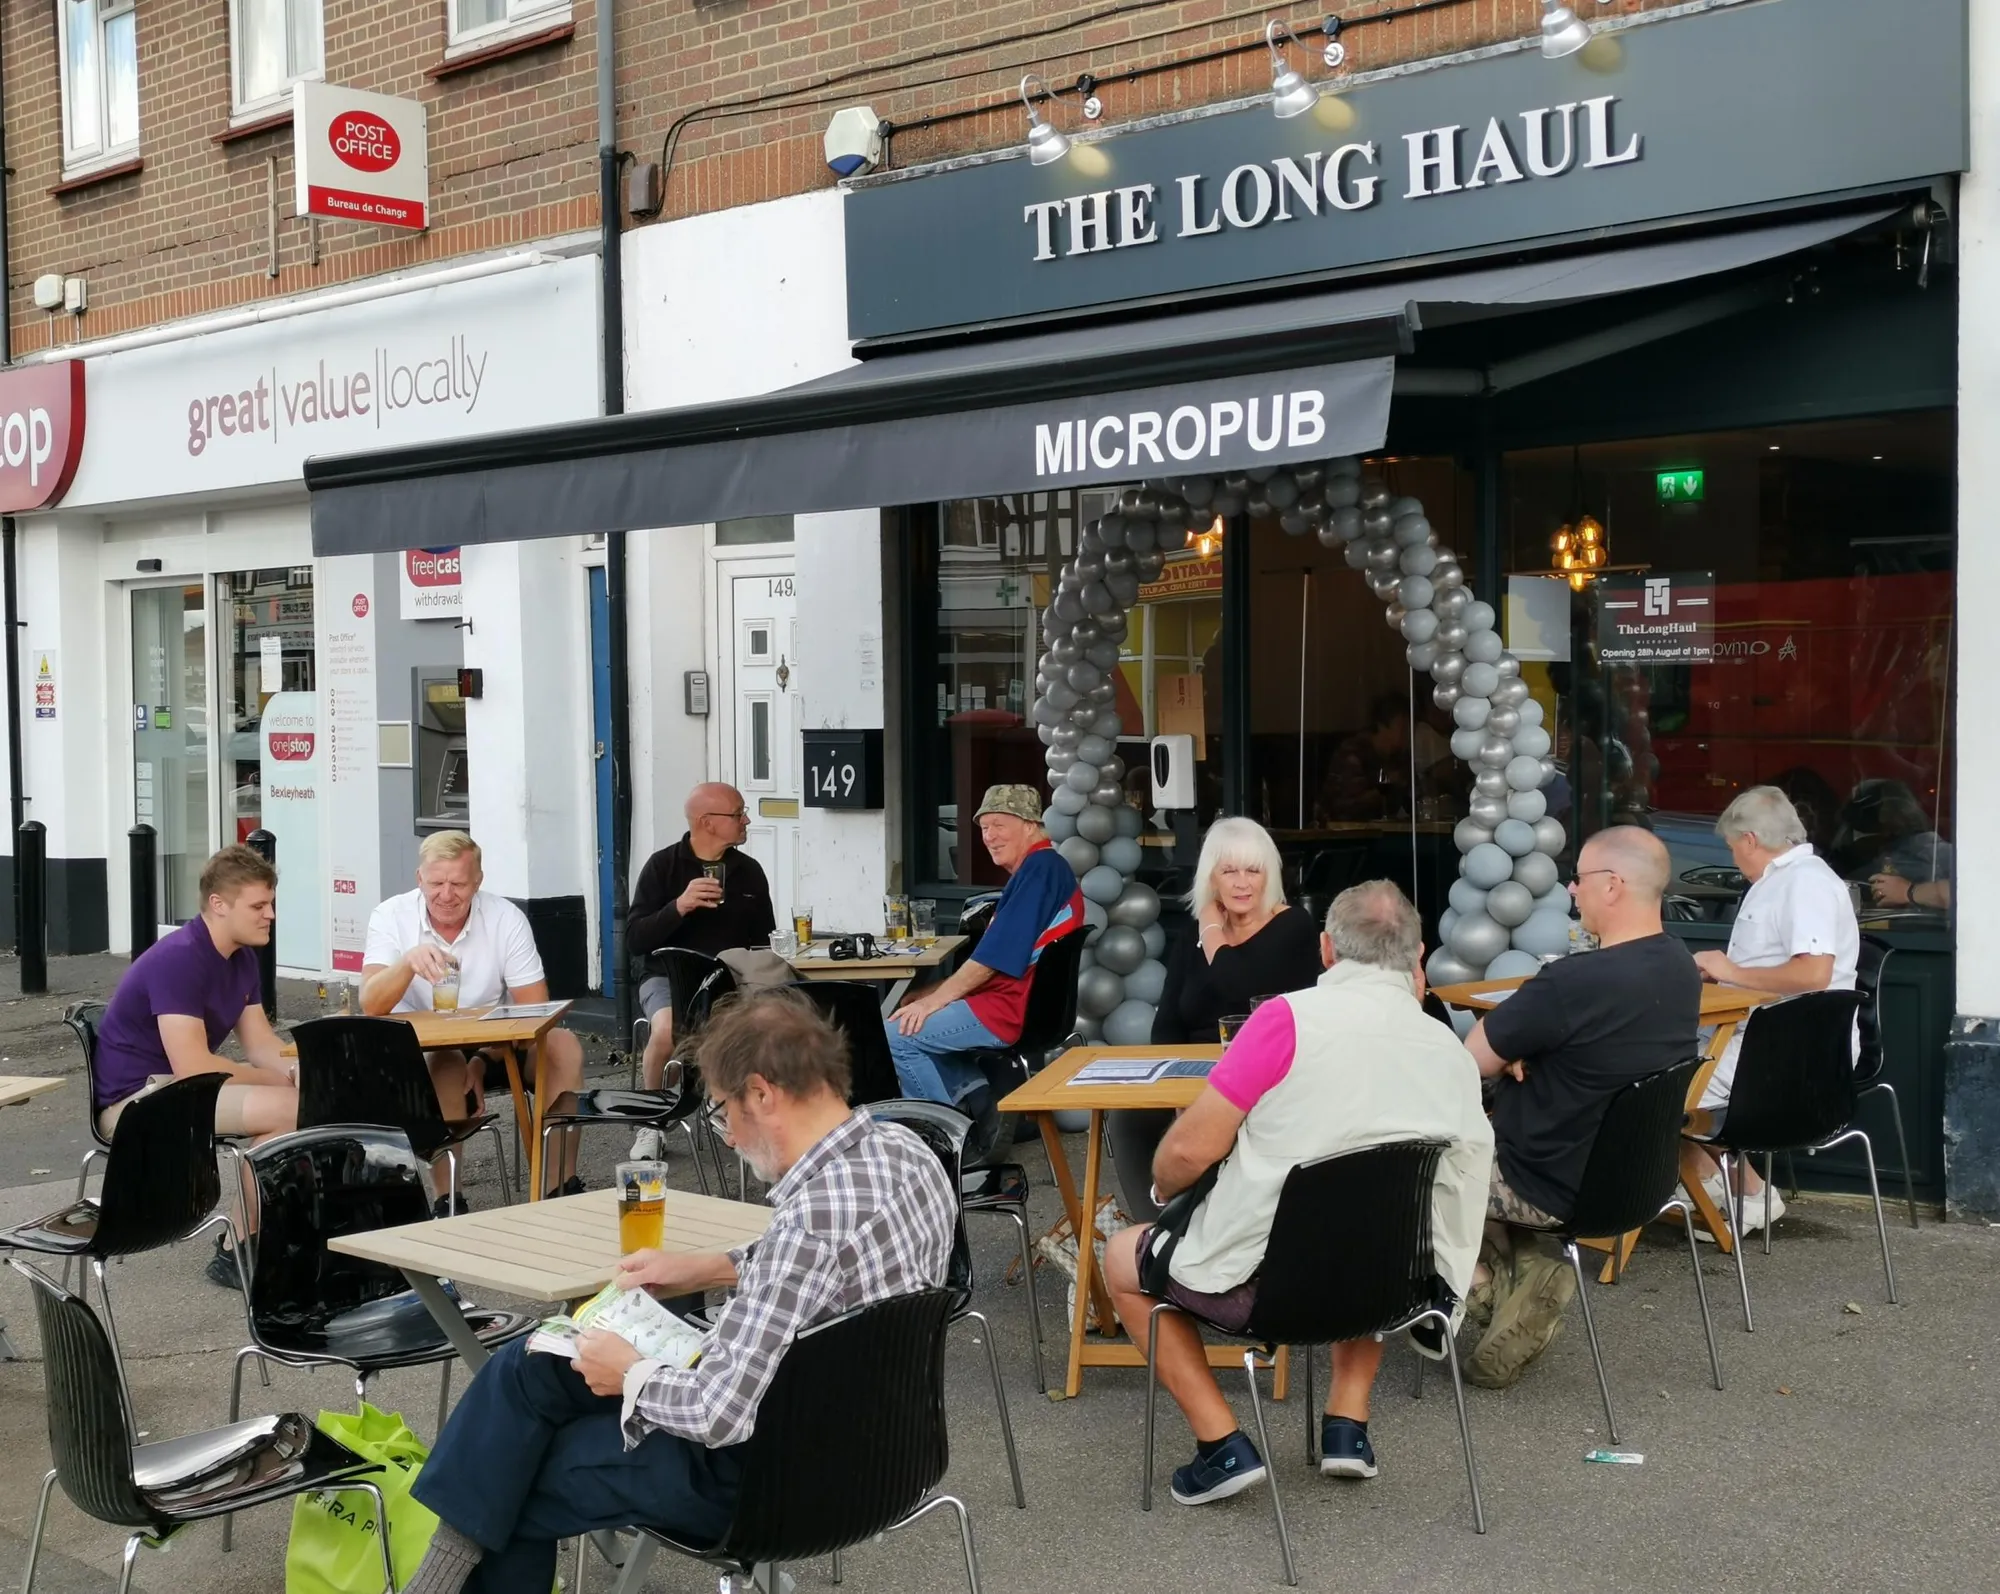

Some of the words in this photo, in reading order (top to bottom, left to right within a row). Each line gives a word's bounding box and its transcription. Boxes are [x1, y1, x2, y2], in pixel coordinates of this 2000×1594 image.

[345, 121, 387, 142] POST
[335, 137, 393, 160] OFFICE
[1024, 182, 1158, 261] THE
[1175, 141, 1378, 238] LONG
[1401, 95, 1639, 199] HAUL
[327, 196, 360, 211] Bureau
[362, 202, 373, 212] de
[375, 204, 407, 218] Change
[188, 375, 270, 456] great
[281, 358, 371, 423] value
[384, 334, 488, 414] locally
[1035, 389, 1326, 476] MICROPUB
[412, 555, 434, 576] free
[437, 557, 461, 574] cas
[1617, 622, 1697, 636] TheLongHaul
[1601, 649, 1635, 658] Opening
[1637, 648, 1654, 656] 28th
[1655, 648, 1681, 657] August
[1683, 648, 1691, 656] at
[1693, 647, 1710, 656] 1pm
[269, 714, 303, 726] welcome
[305, 715, 314, 727] to
[290, 737, 311, 757] stop
[811, 764, 856, 798] 149
[270, 784, 315, 801] Bexleyheath
